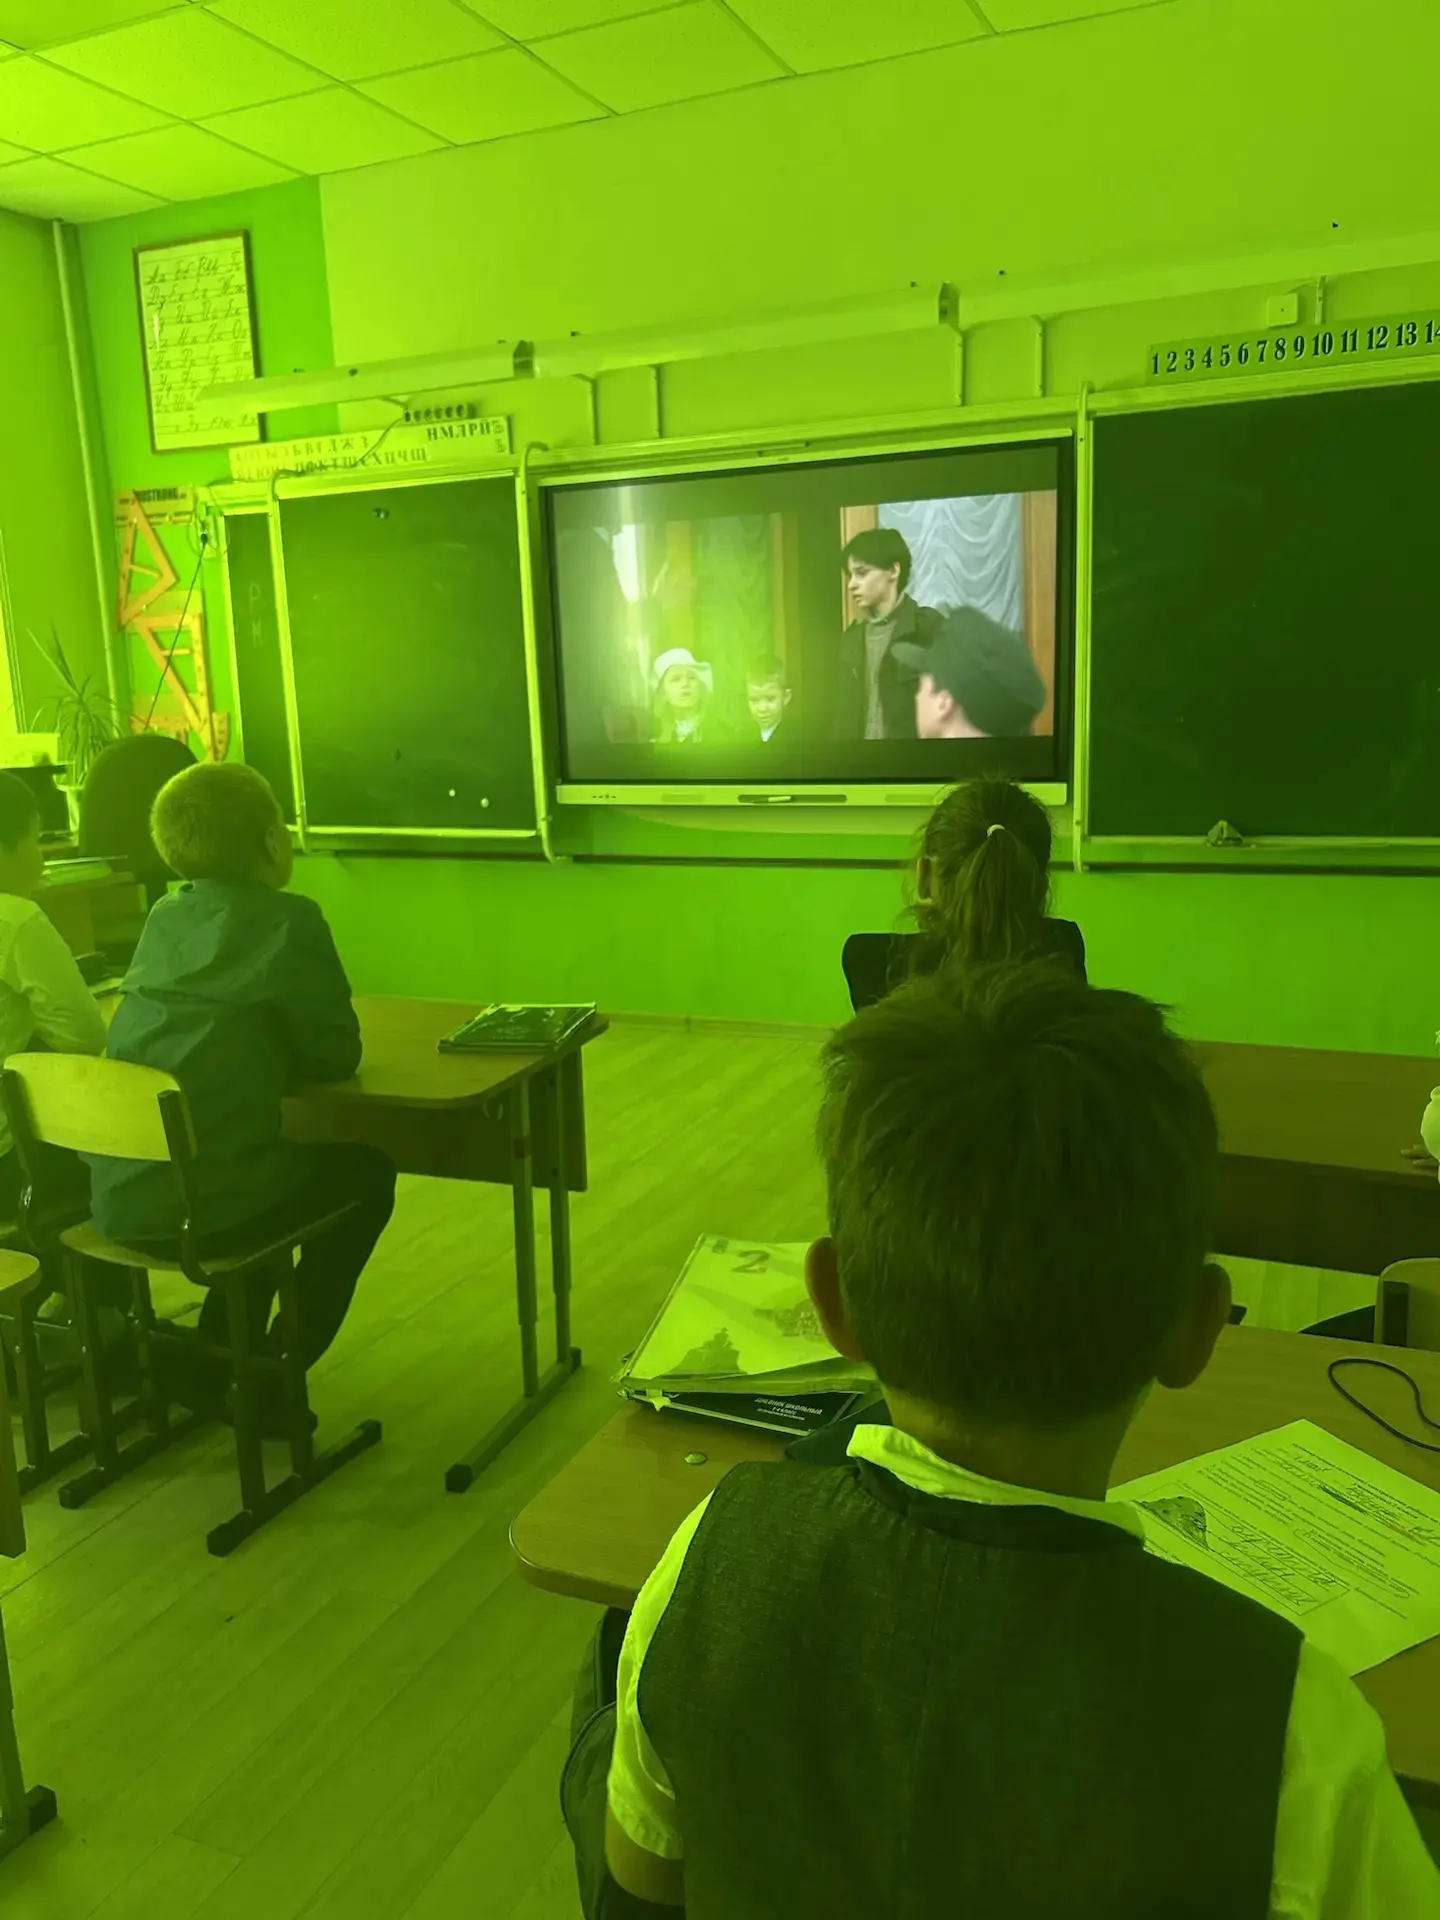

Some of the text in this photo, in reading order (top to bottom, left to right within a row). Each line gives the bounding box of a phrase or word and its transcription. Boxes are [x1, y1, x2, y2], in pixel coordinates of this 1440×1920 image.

[1152, 353, 1159, 375] 1
[1167, 351, 1178, 374] 2
[1184, 349, 1195, 371] 3
[1202, 347, 1213, 369] 4
[1220, 344, 1231, 368] 5
[1238, 342, 1249, 365] 6
[1257, 340, 1268, 363] 7
[1275, 338, 1286, 361] 8
[1294, 336, 1305, 359] 9
[1312, 332, 1333, 357] 10
[1341, 328, 1358, 353] 11
[1367, 326, 1389, 351] 12
[1396, 322, 1417, 347] 13
[731, 1250, 771, 1274] 2
